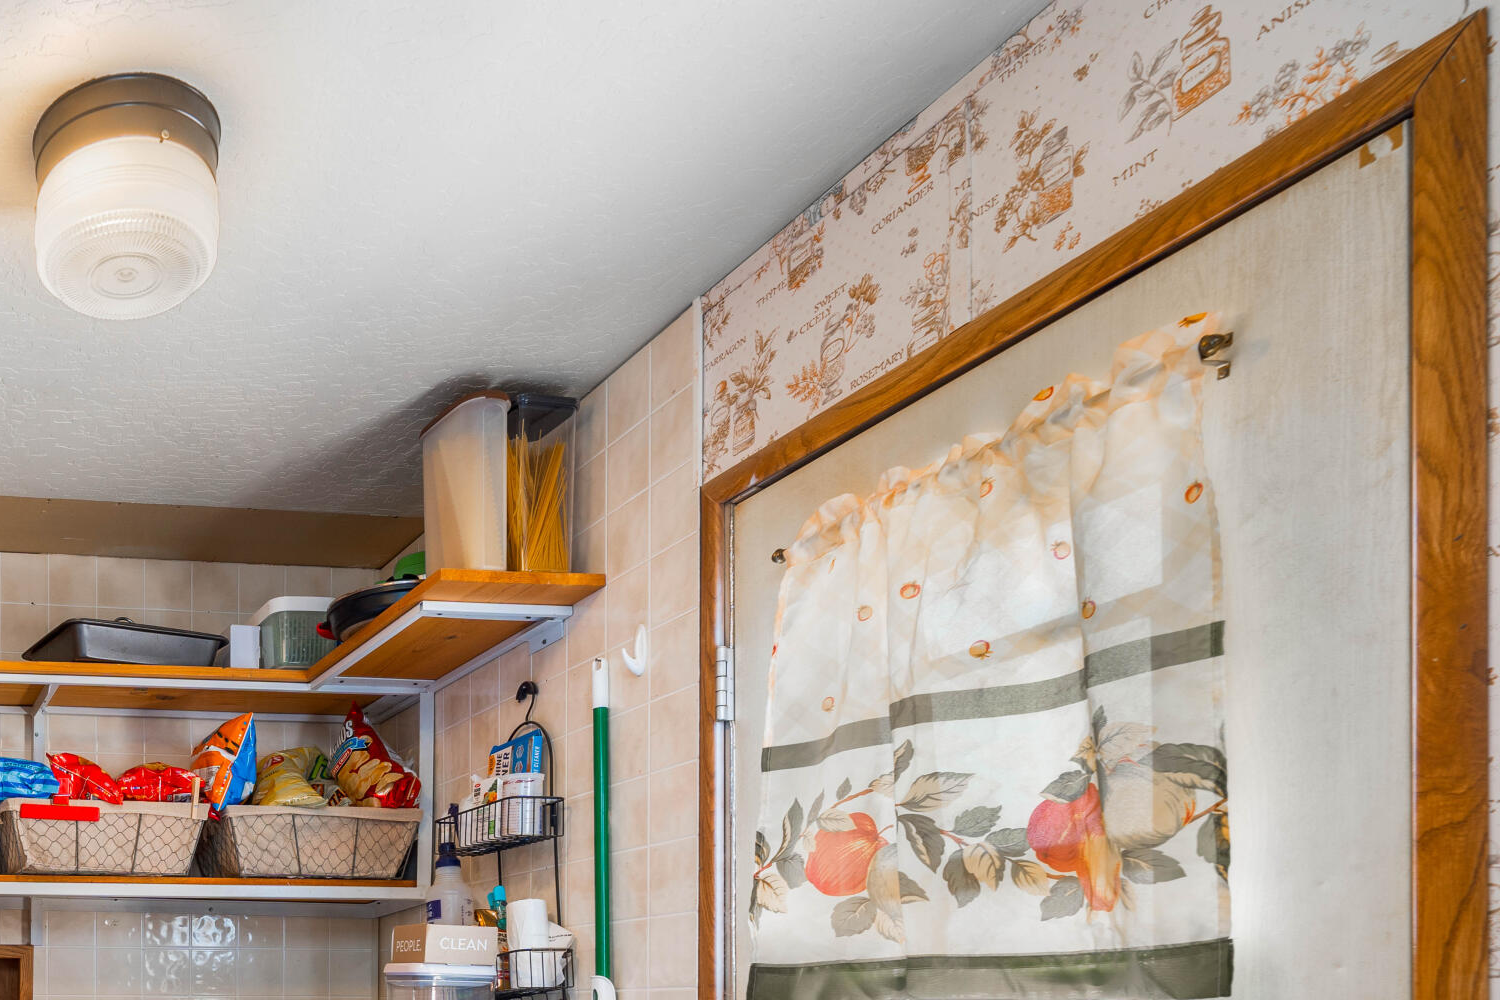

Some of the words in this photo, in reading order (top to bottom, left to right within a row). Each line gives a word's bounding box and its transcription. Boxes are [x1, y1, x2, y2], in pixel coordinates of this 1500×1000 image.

[1111, 148, 1158, 187] MINT
[870, 180, 936, 235] CORIANDER
[756, 281, 788, 307] THYME
[813, 282, 848, 315] SWEET
[799, 306, 834, 337] CICELY
[703, 335, 748, 372] TARRAGON
[848, 347, 906, 391] ROSEMARY
[438, 935, 489, 952] CLEAN
